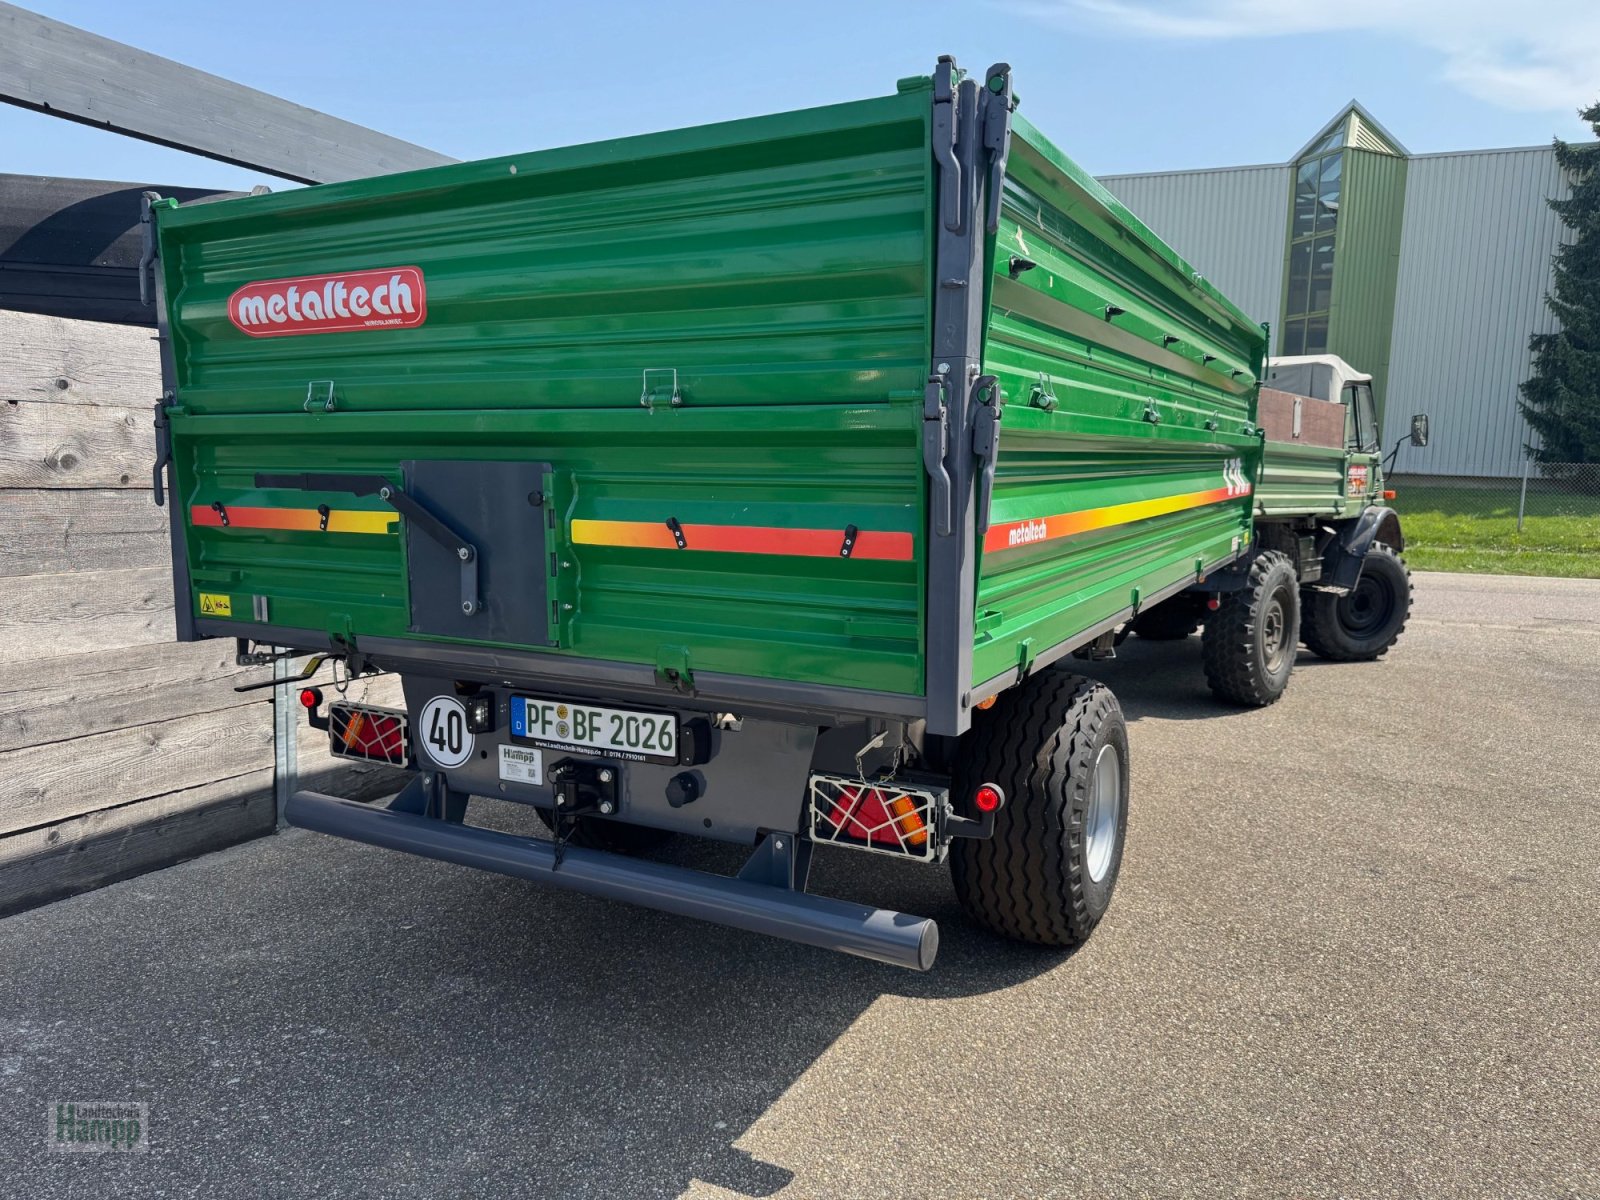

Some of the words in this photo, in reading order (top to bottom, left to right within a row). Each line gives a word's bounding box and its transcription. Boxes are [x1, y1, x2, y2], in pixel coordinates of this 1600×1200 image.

[238, 274, 416, 326] metaltech
[1008, 517, 1047, 546] metaltech
[429, 707, 462, 755] 40
[515, 720, 522, 730] D
[526, 703, 554, 735] PF
[573, 709, 603, 742] BF
[610, 714, 673, 751] 2026
[503, 748, 534, 763] Hampp
